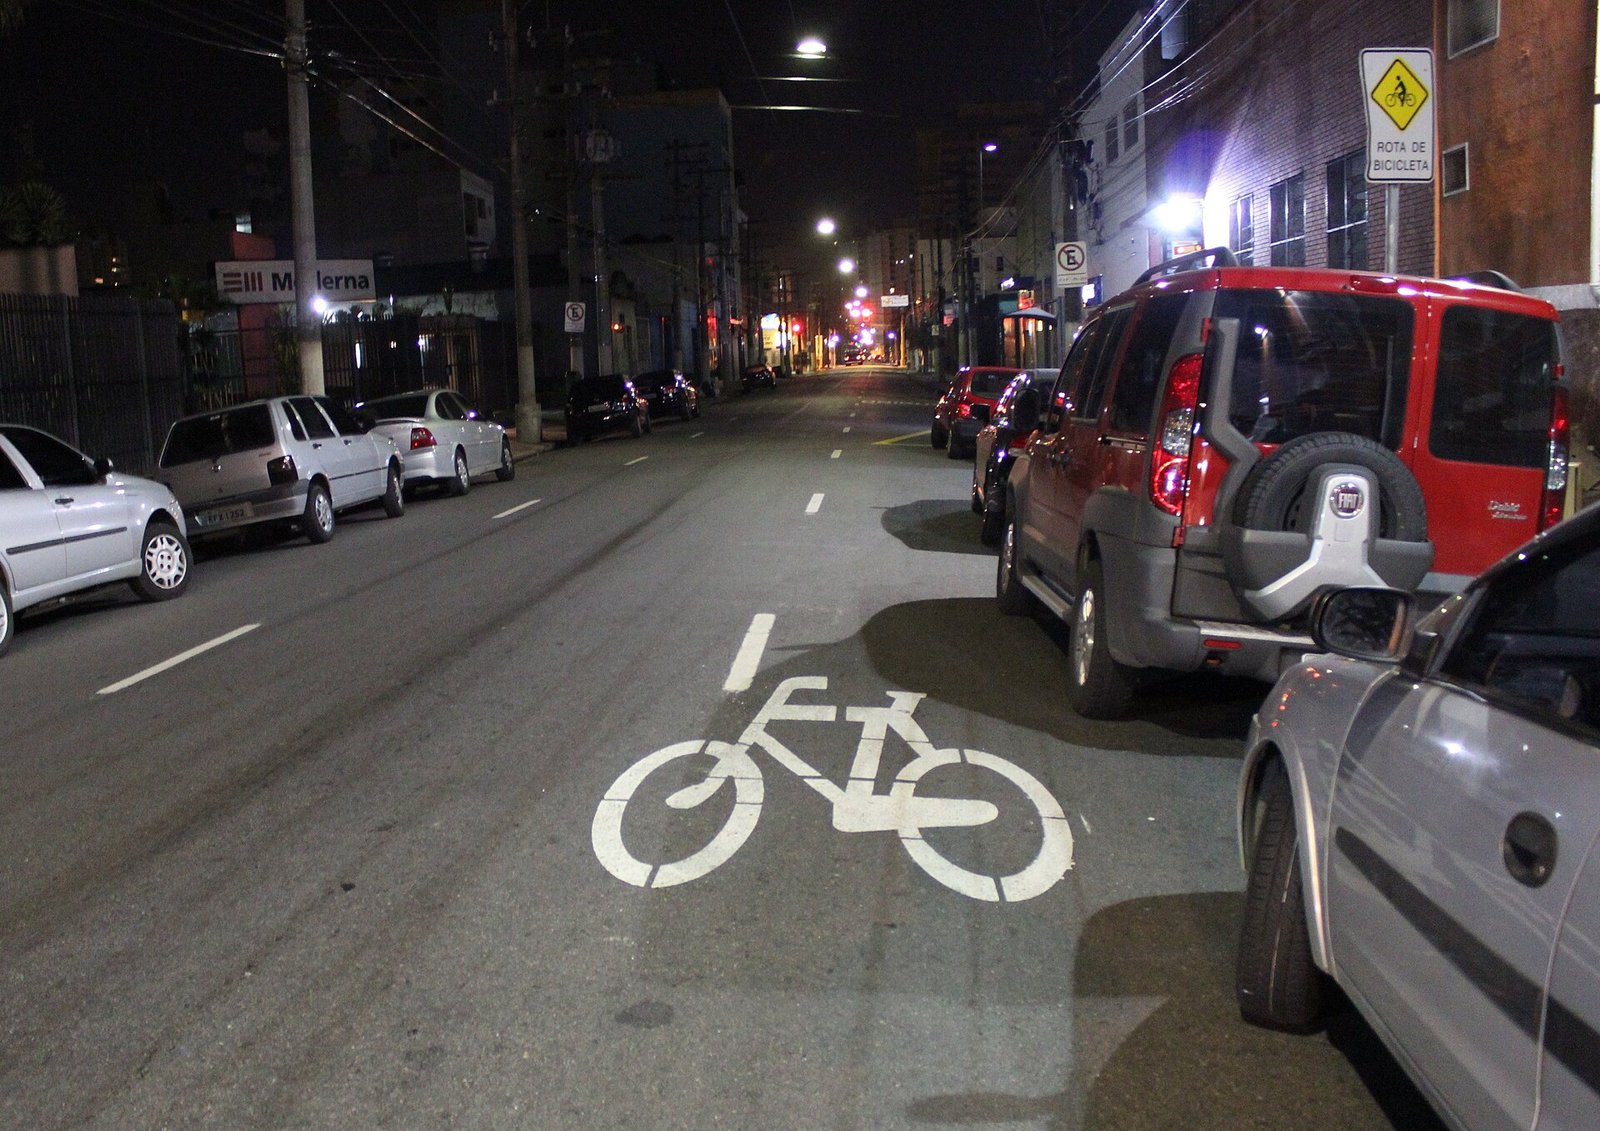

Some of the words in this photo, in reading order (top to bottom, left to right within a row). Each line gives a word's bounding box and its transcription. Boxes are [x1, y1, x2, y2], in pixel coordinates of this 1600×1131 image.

[1377, 141, 1407, 153] ROTA
[1412, 141, 1426, 153] DE
[1373, 159, 1429, 171] BICICLETA
[271, 270, 370, 292] Merna
[1338, 492, 1359, 509] FIAT
